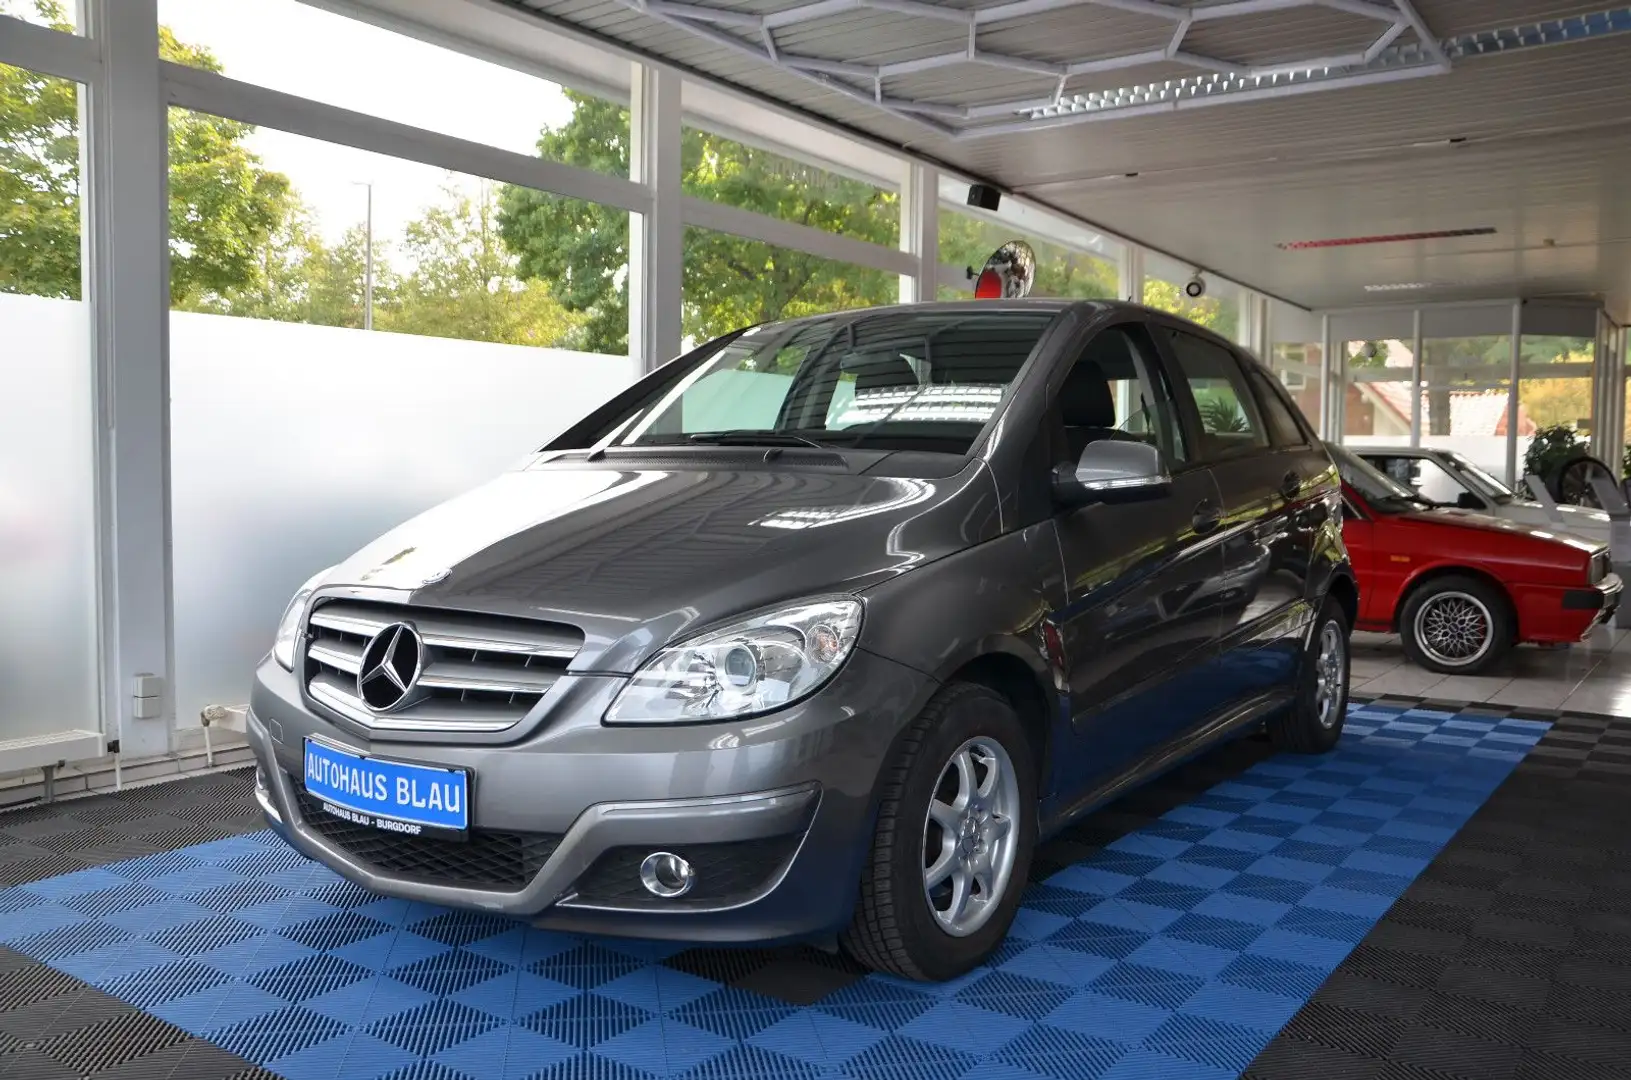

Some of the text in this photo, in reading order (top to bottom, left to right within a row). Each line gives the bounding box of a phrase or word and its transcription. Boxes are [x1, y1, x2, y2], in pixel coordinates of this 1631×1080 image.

[307, 752, 460, 813] AUTOHAUS BLAU
[323, 802, 351, 821] AUTOHAUS
[351, 812, 369, 826] BLAU
[376, 818, 422, 835] BURGDORF
